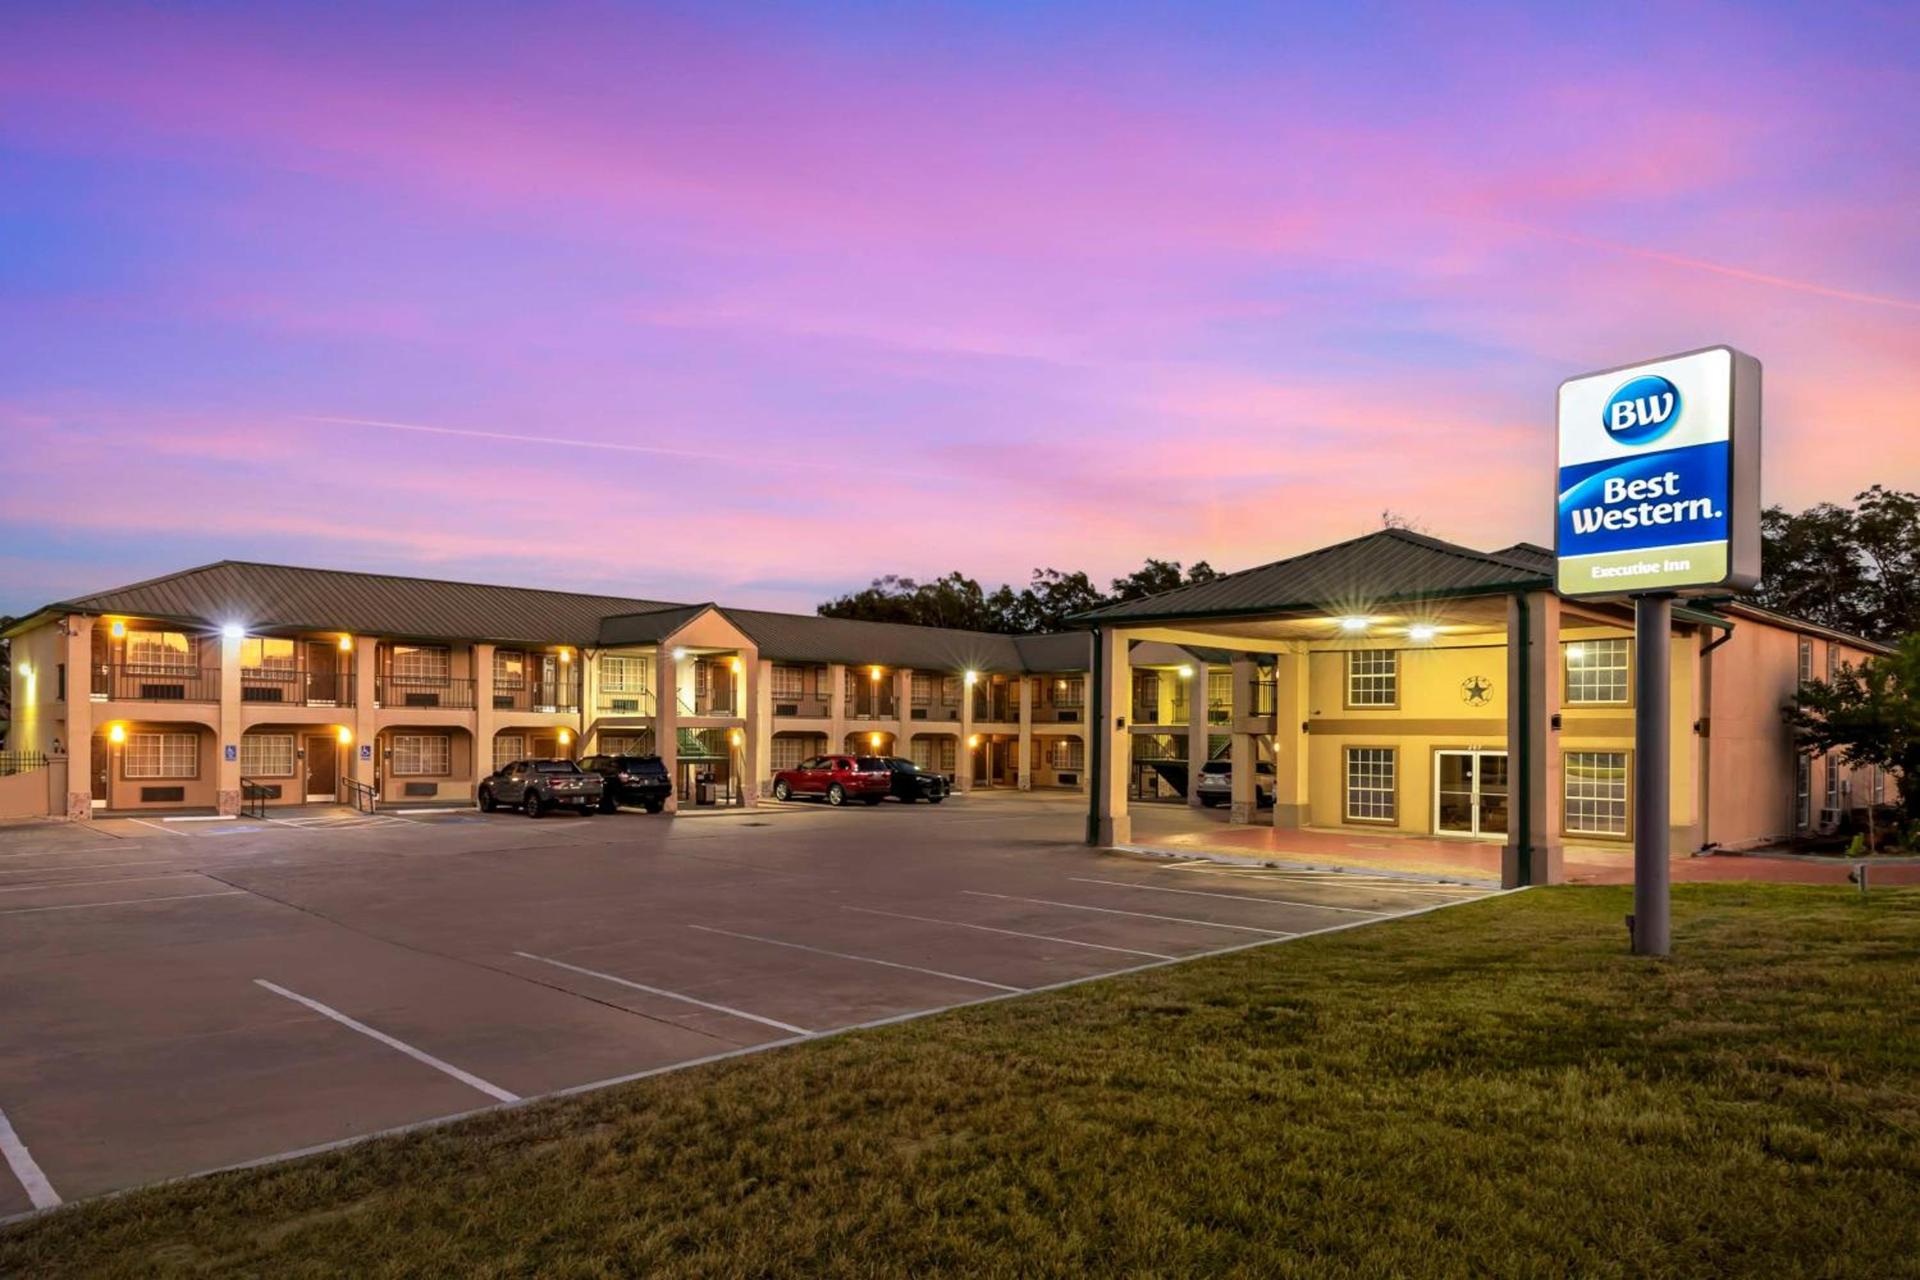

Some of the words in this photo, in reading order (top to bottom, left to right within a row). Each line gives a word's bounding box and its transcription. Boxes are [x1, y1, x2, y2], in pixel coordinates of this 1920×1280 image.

[1611, 392, 1674, 431] BW
[1604, 472, 1680, 504] Best
[1571, 498, 1723, 534] Western.
[1592, 562, 1660, 578] Executive
[1664, 560, 1690, 572] Inn
